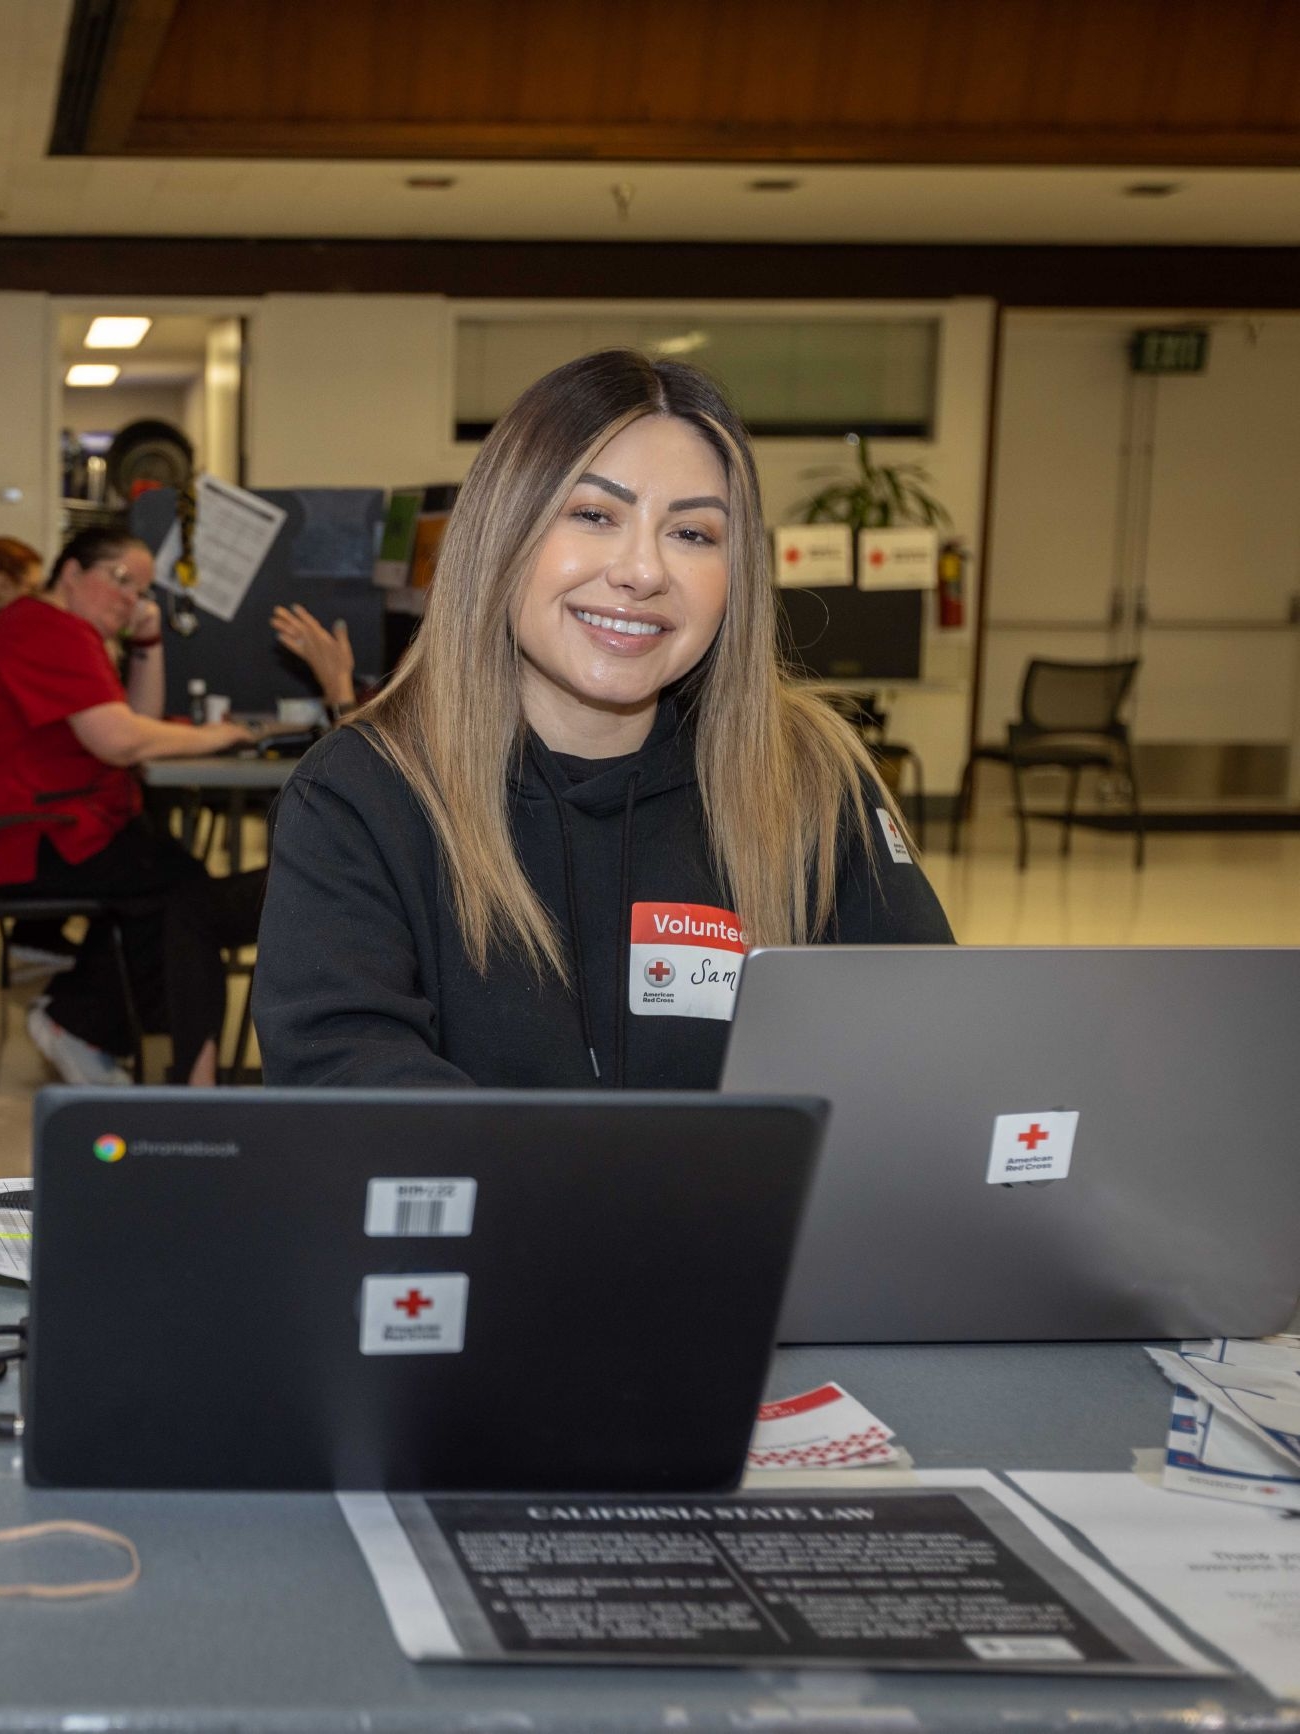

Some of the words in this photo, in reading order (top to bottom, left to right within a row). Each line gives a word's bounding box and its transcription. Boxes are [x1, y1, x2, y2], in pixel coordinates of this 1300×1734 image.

[653, 914, 749, 945] Voluntee
[691, 958, 736, 991] Sam
[1007, 1155, 1053, 1164] American
[1005, 1164, 1024, 1172] Red
[527, 1506, 712, 1520] CALIFORNIA
[713, 1507, 807, 1521] STATE
[809, 1507, 875, 1521] LAW
